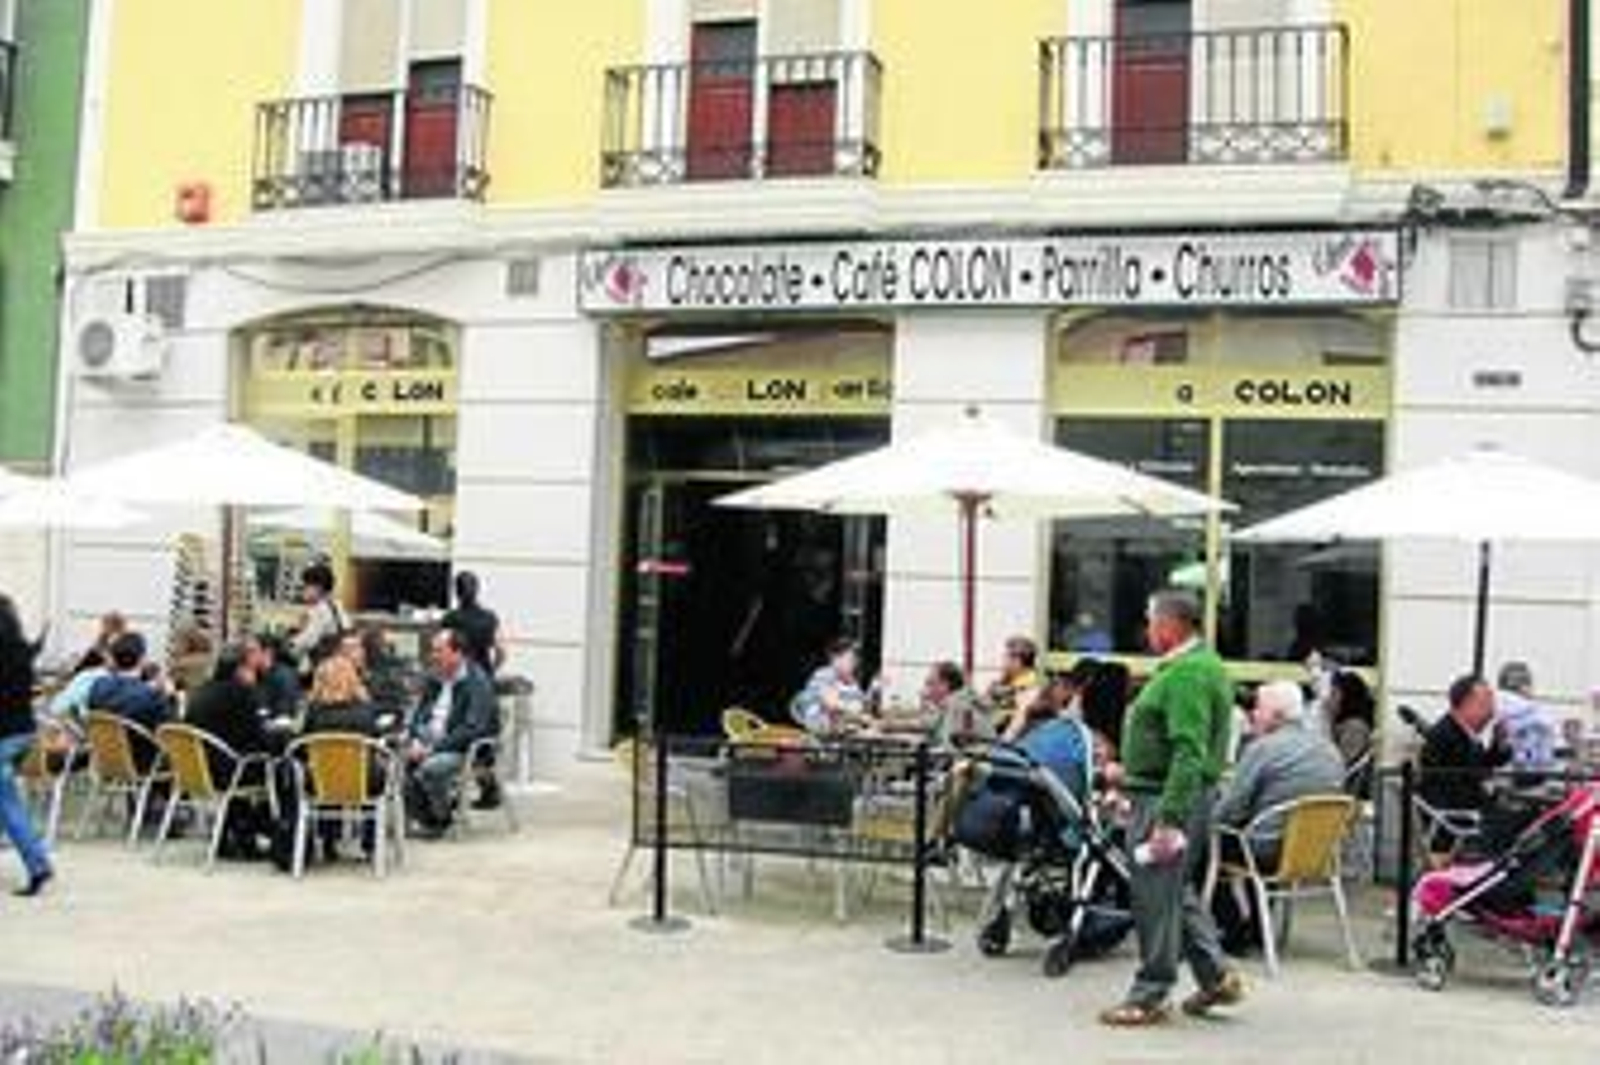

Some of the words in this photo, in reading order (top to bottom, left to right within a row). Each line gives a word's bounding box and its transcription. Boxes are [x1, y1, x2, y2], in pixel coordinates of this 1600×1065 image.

[667, 254, 804, 304] Chocolate
[832, 248, 897, 300] Café
[911, 246, 1012, 300] COLON
[1043, 244, 1141, 299] Parrilla
[1174, 241, 1292, 298] Churros
[1234, 380, 1353, 405] COLON
